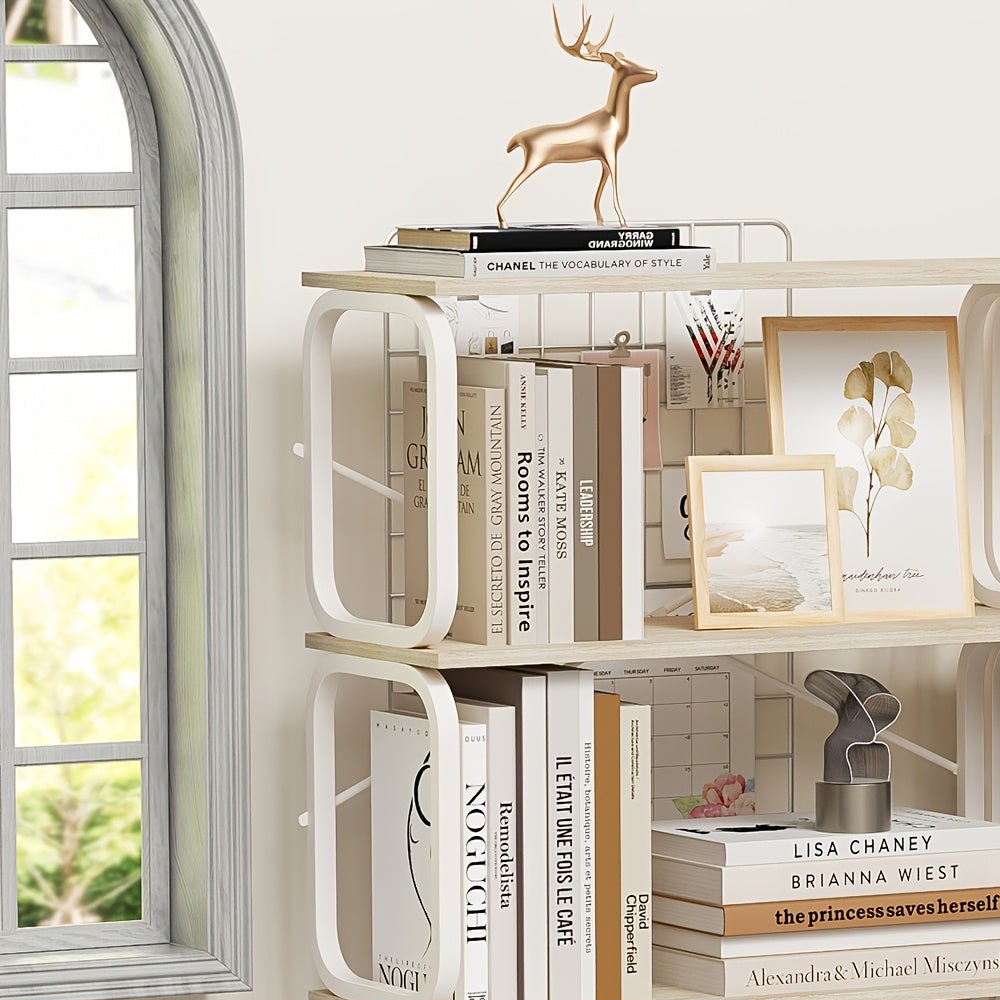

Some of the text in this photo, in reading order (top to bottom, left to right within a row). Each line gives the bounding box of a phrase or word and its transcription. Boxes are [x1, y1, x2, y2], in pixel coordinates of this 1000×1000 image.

[486, 262, 536, 272] CHANEL
[539, 261, 559, 270] THE
[561, 258, 631, 270] VOCABULARY
[634, 259, 649, 268] OF
[651, 258, 682, 268] STYLE
[490, 406, 503, 634] EL SECRETO DE GRAY MOUNTAIN
[514, 452, 534, 632] Rooms to Inspire
[538, 448, 546, 590] TIM WALKER STORY TELLER
[556, 471, 568, 560] KATE MOSS
[580, 480, 594, 547] LEADERSHIP
[466, 783, 487, 944] NOGUCHI
[500, 802, 516, 910] Remodelista
[556, 756, 576, 946] IL ÉTAIT UNE FOIS LE CAFÉ
[791, 864, 960, 890] BRIANNA WIEST
[793, 835, 933, 859] LISA CHANEY
[626, 894, 638, 974] Chipperfield
[638, 894, 650, 930] David
[774, 894, 1000, 928] the princess saves herself
[744, 963, 831, 988] Alexandra
[834, 966, 848, 982] &
[850, 956, 918, 980] Michael
